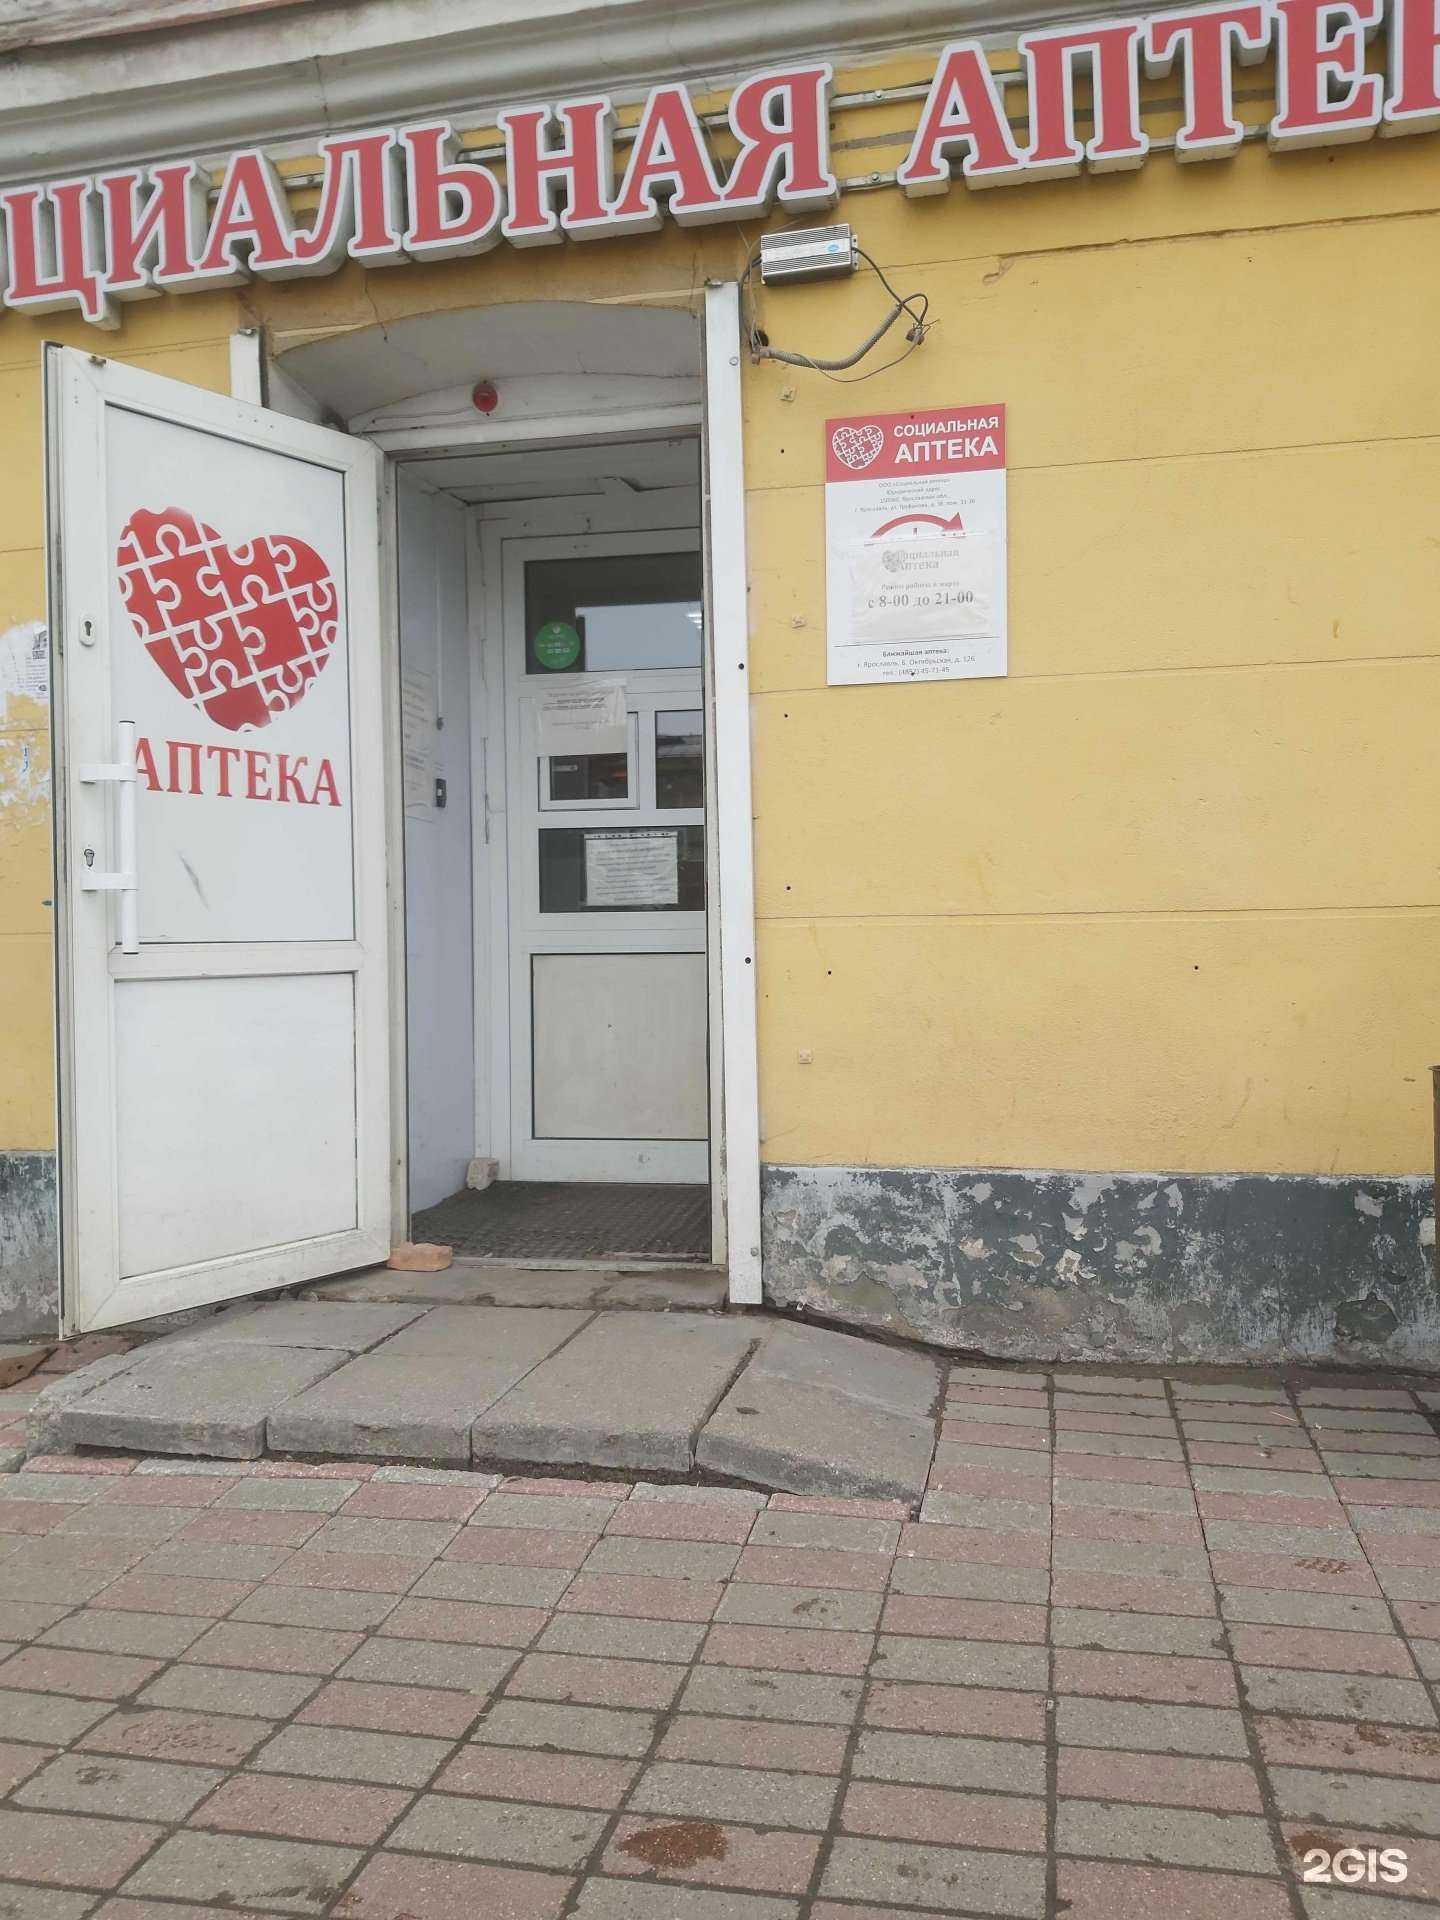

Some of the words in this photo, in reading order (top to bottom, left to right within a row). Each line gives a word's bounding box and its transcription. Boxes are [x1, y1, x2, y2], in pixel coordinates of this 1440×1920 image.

[893, 416, 999, 438] СОЦИАЛЬНАЯ
[894, 435, 999, 464] АПТЕКА
[879, 594, 909, 608] 8-00
[935, 590, 974, 605] 21-00
[135, 736, 343, 807] АПТЕКА
